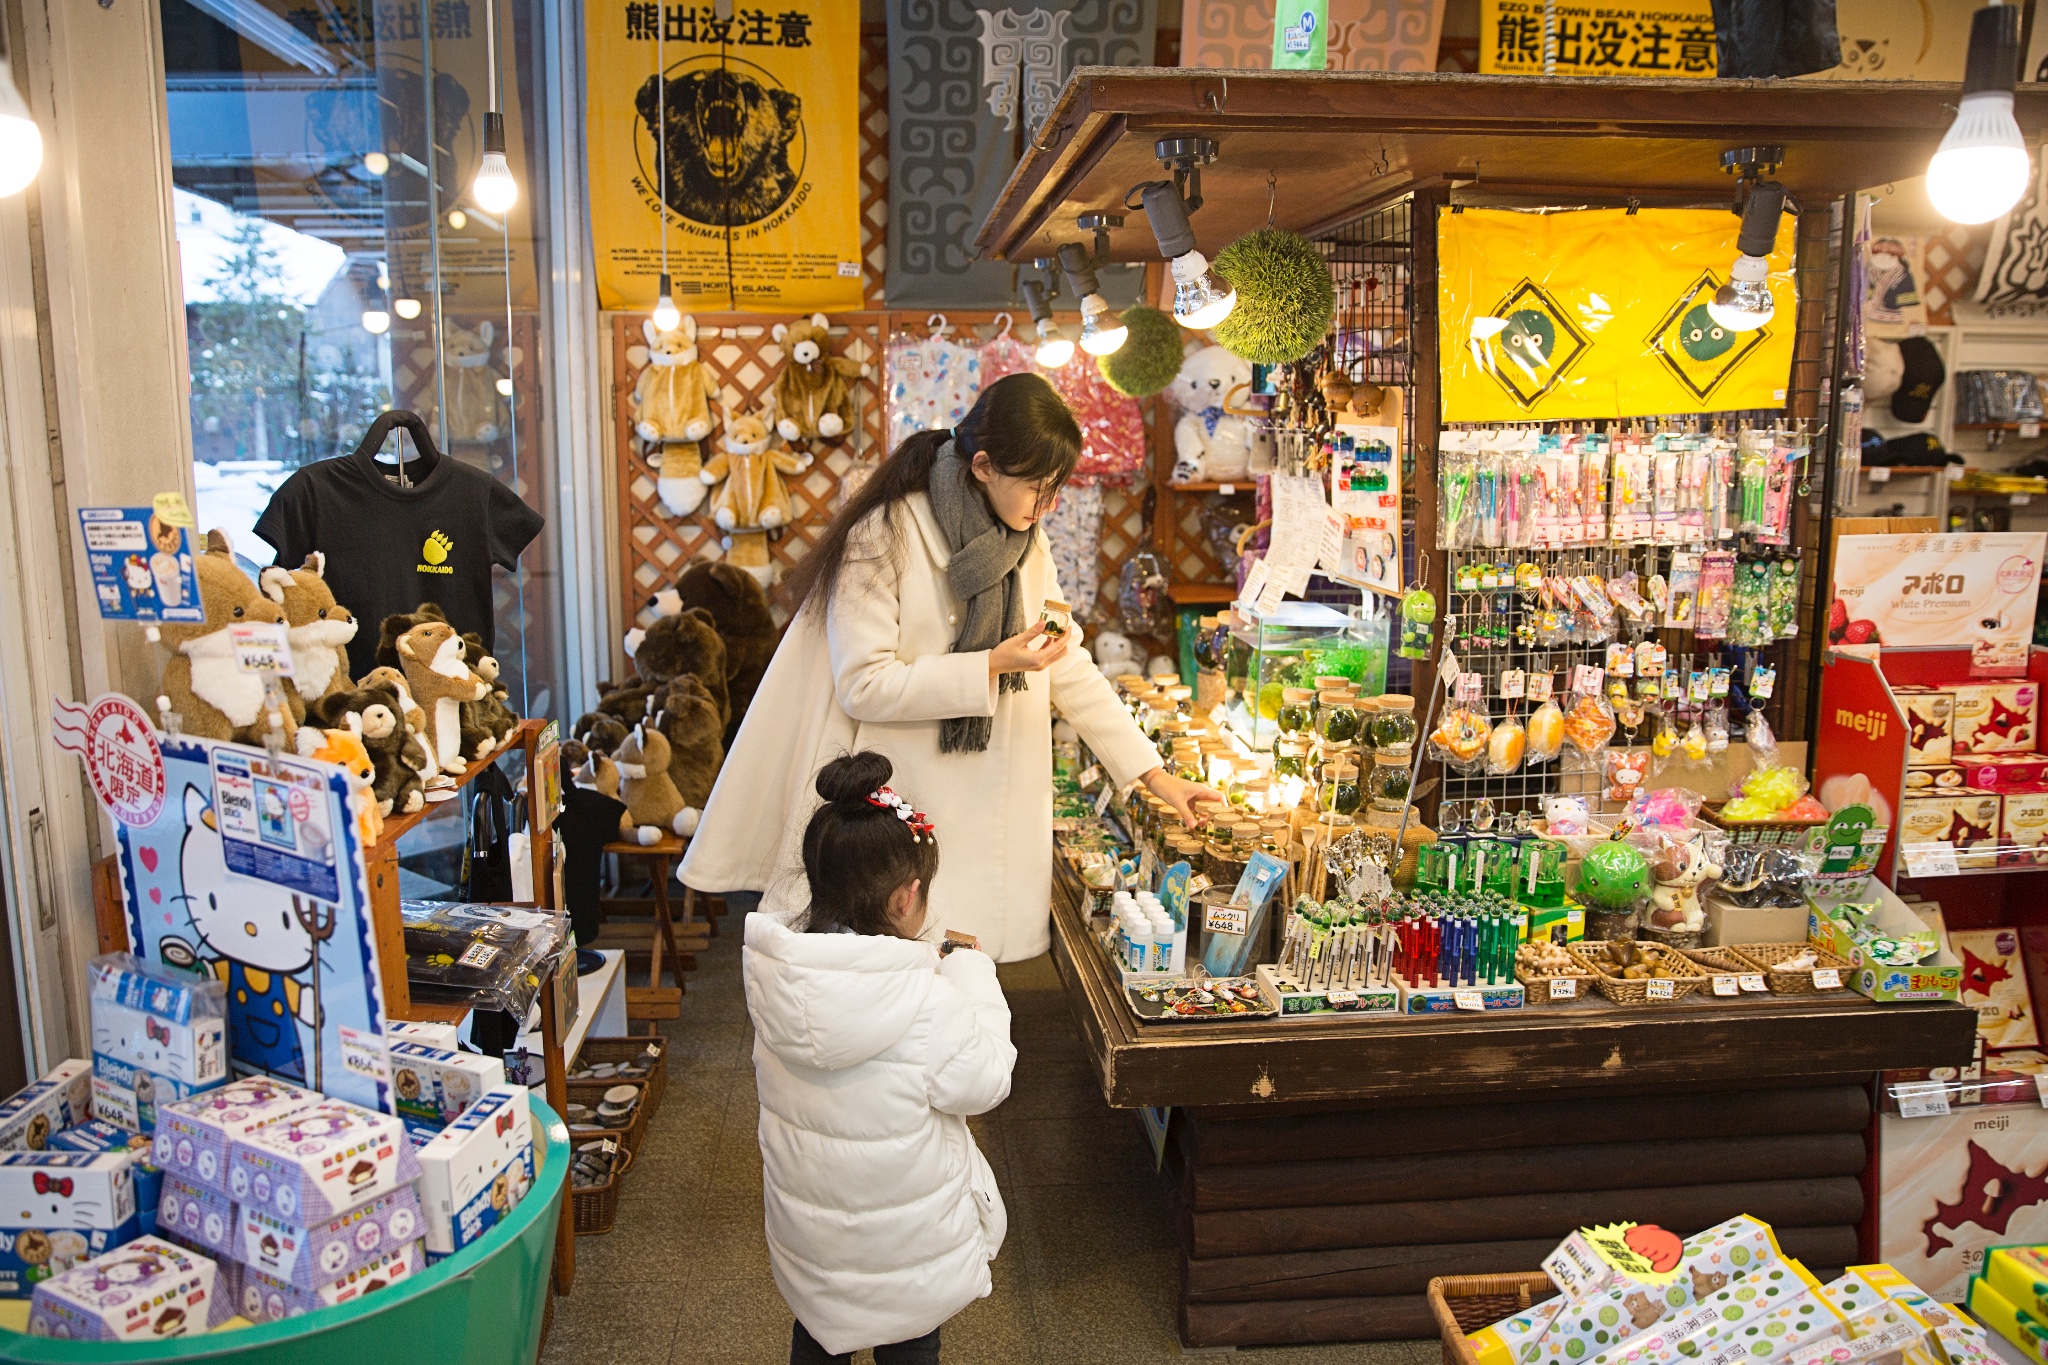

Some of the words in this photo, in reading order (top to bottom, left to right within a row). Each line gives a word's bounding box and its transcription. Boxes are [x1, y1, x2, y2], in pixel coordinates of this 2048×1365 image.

[1302, 14, 1313, 31] M
[1498, 2, 1529, 13] EZO
[1534, 4, 1590, 17] BOWN
[1595, 8, 1635, 19] BEAR
[625, 1, 812, 48] 熊出没注意
[1497, 14, 1717, 72] 熊出没注意
[631, 175, 648, 196] WE
[677, 221, 740, 241] ANIMALS
[746, 228, 759, 240] IN
[416, 564, 453, 574] HOKKAIDO
[1838, 586, 1865, 598] meiji
[1902, 572, 1965, 595] アポロ
[1890, 600, 1919, 610] White
[1922, 598, 1971, 609] Premium
[89, 701, 141, 740] HOKKAIDO
[1836, 708, 1887, 741] meiji
[98, 740, 154, 795] 北海道
[110, 774, 141, 811] 限定
[221, 791, 252, 811] Blendy
[111, 788, 164, 825] HOKKAIDO
[1208, 920, 1233, 931] ¥648
[1213, 911, 1240, 921] ムックリ
[1288, 998, 1325, 1012] まりも
[97, 1056, 135, 1086] Blendy
[97, 1102, 124, 1124] ¥648
[1974, 1116, 2010, 1131] meiji
[460, 1187, 492, 1231] Blendy
[461, 1216, 482, 1245] stick
[1551, 1256, 1576, 1286] ¥540
